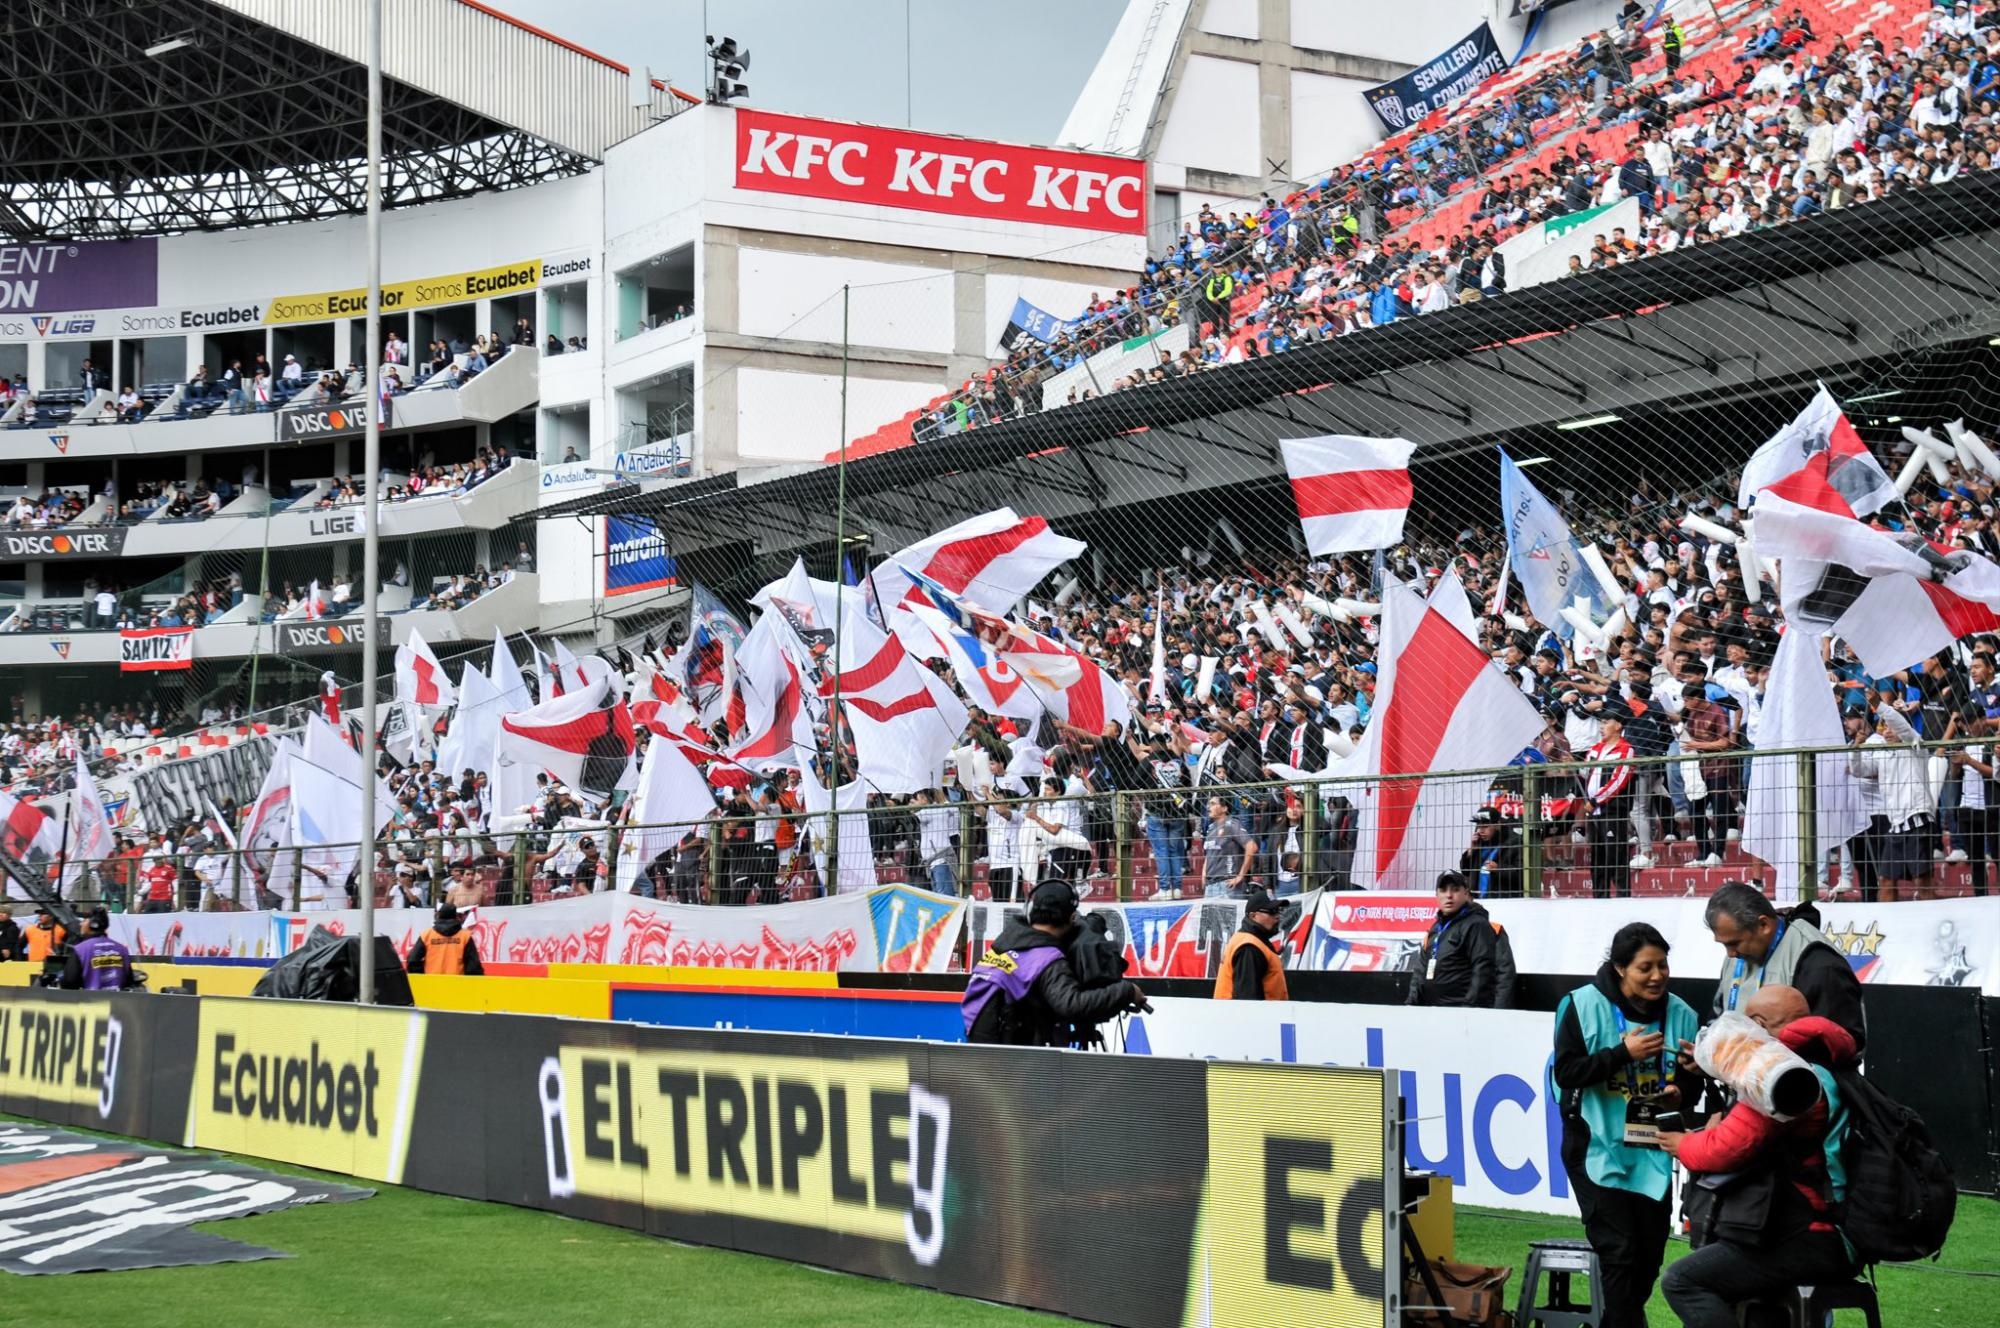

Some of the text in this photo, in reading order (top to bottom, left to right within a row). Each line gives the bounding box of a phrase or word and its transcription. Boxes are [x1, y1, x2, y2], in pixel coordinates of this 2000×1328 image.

[1413, 40, 1479, 92] SEMILLERO
[1405, 51, 1503, 121] DEL CONTINENTE
[741, 128, 1141, 219] KFC KFC KFC
[542, 257, 592, 277] Ecuabet
[274, 266, 536, 319] Somos Ecuaor Somos Ecuabet
[122, 315, 175, 331] Somos
[181, 305, 259, 328] Ecuabet
[291, 407, 366, 434] DISCOVE
[8, 534, 110, 555] DISCOVER
[288, 622, 365, 646] DISCOVE
[1960, 873, 1973, 885] 19
[212, 1033, 379, 1137] Ecuabet
